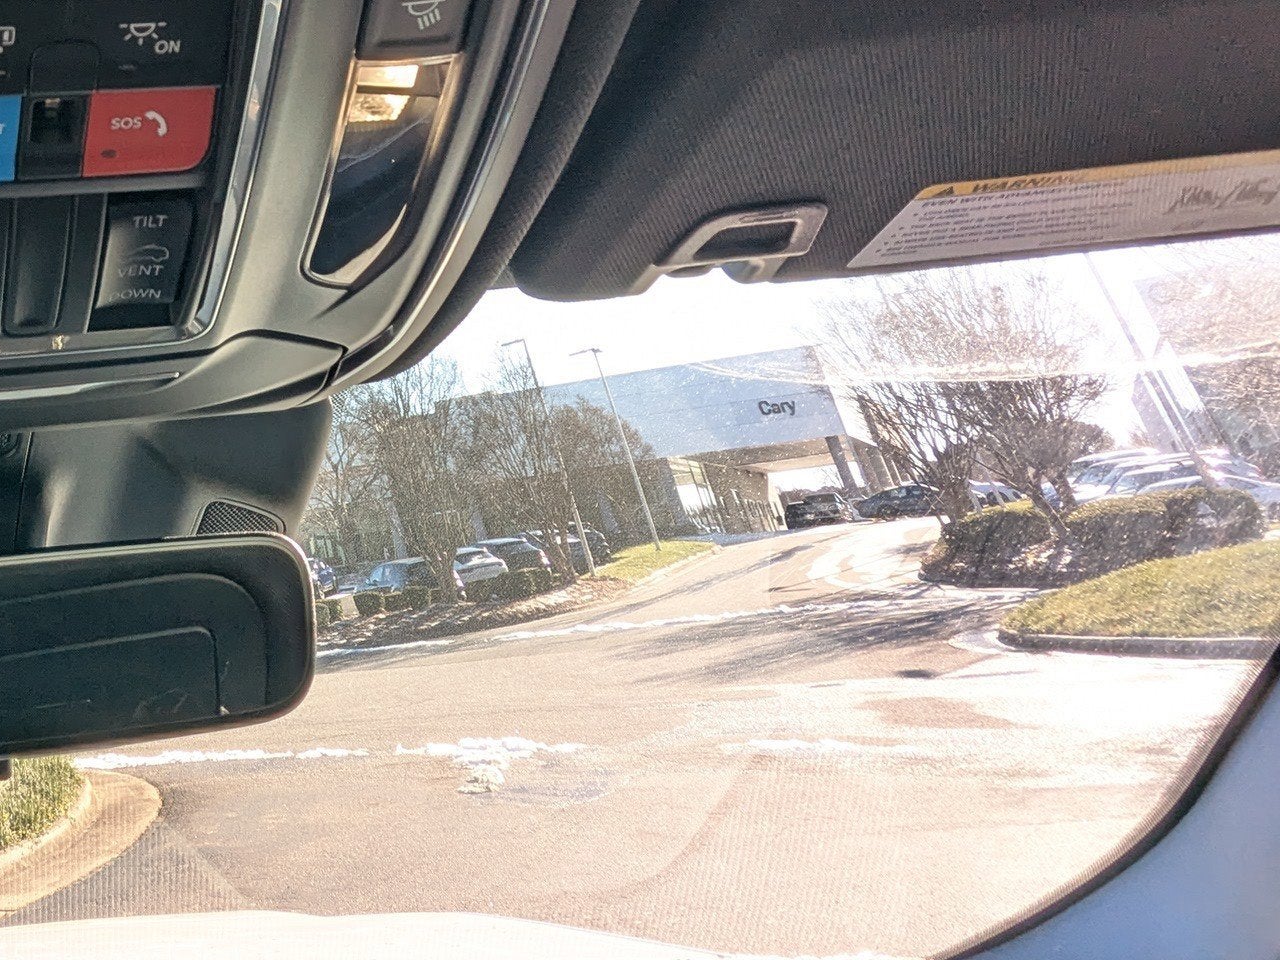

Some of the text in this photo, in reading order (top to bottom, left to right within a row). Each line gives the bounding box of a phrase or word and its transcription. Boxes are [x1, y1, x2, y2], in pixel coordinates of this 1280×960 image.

[153, 39, 181, 55] ON
[110, 116, 142, 131] SOS
[133, 214, 168, 229] TILT
[118, 264, 164, 278] VENT
[758, 400, 796, 416] Cary
